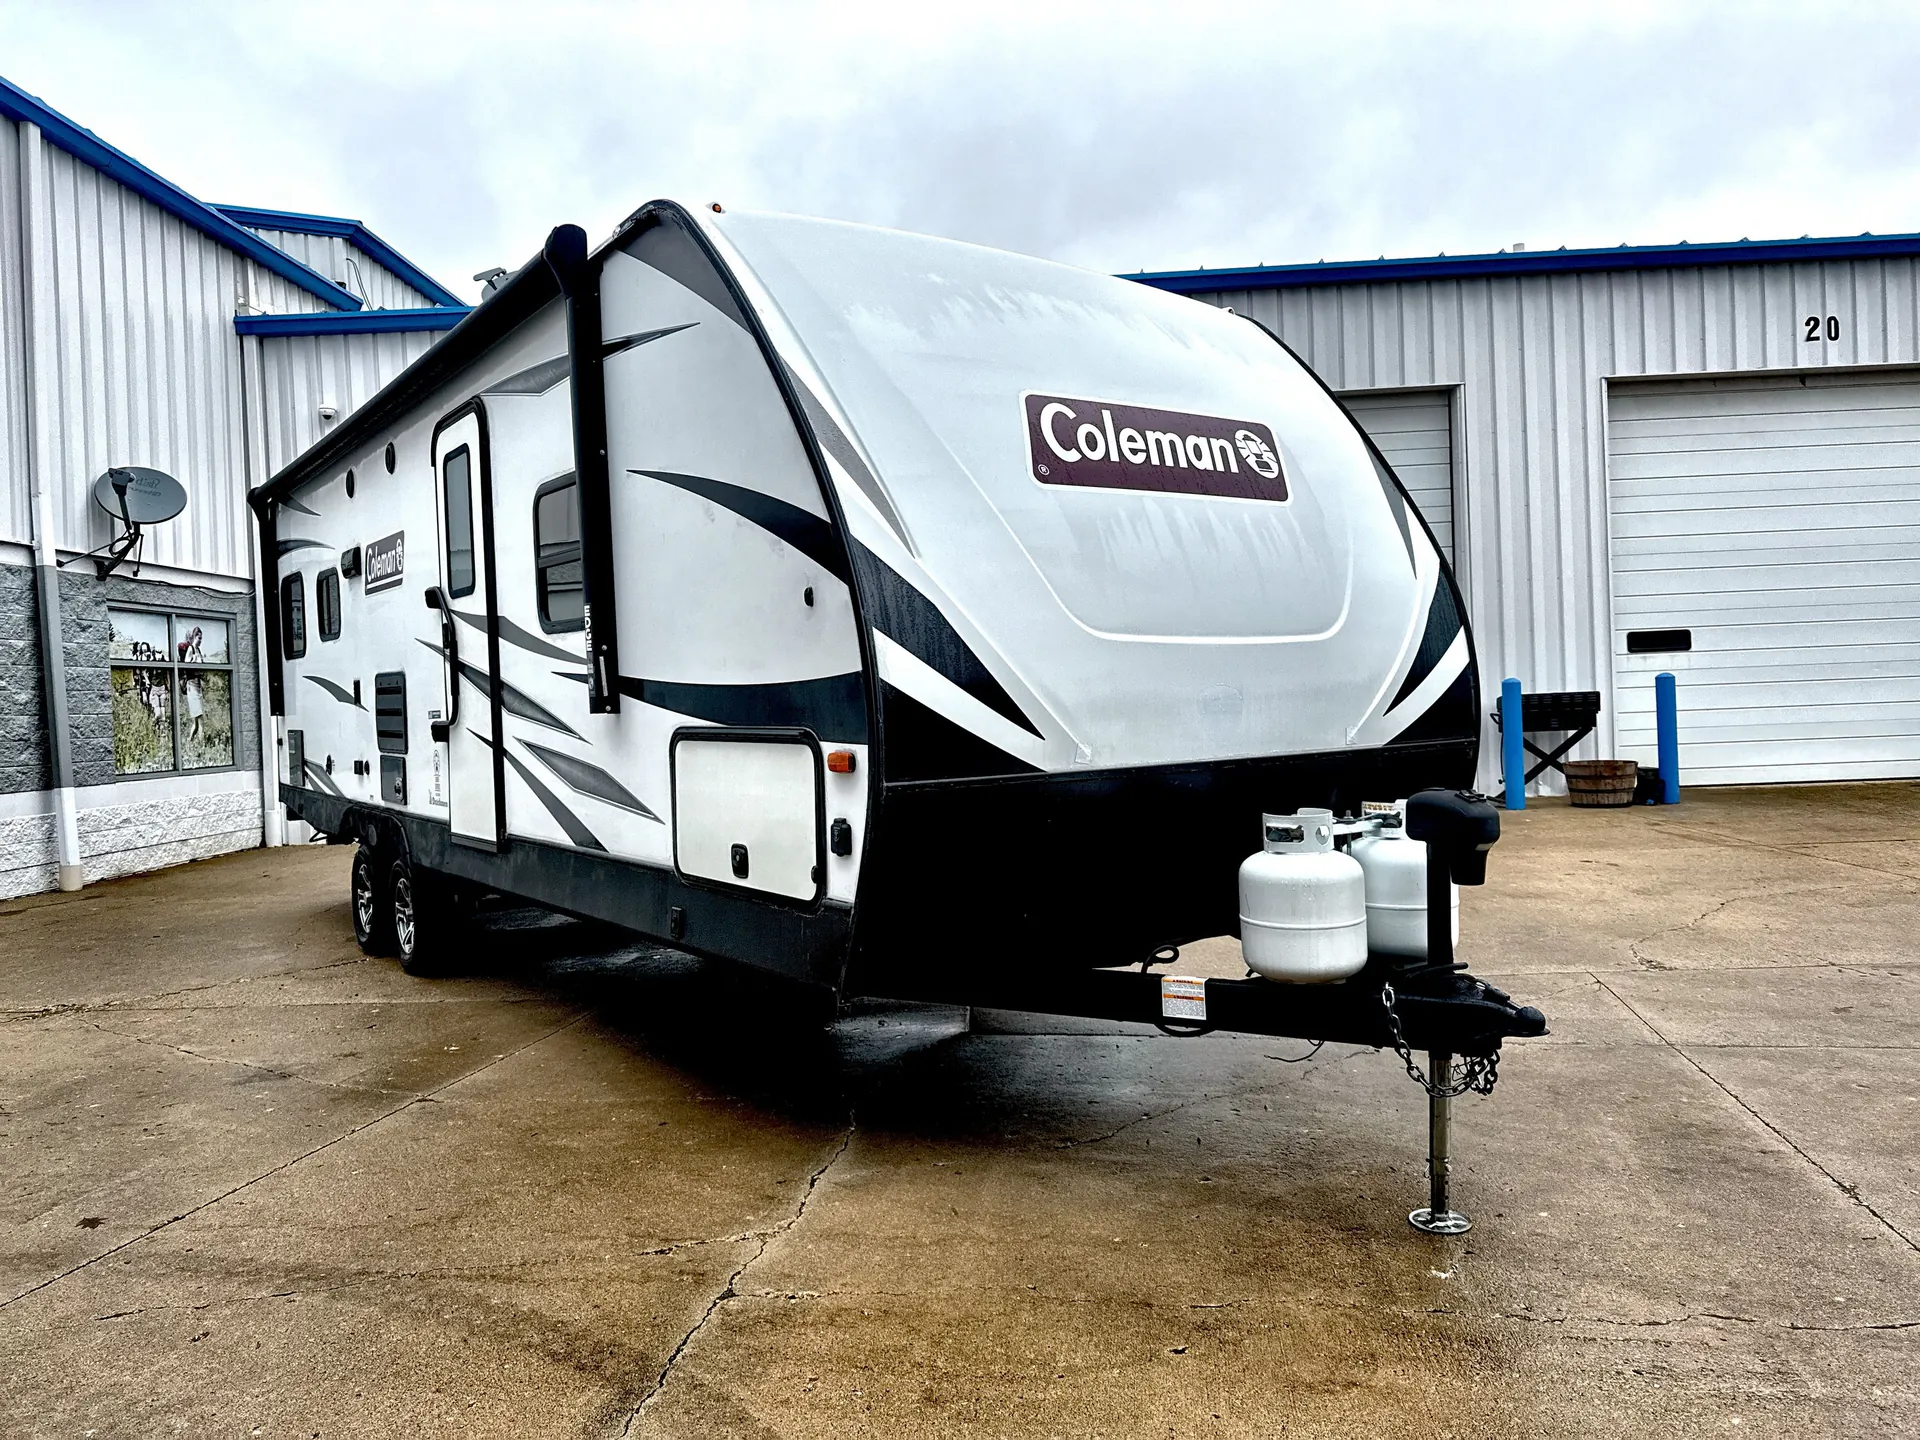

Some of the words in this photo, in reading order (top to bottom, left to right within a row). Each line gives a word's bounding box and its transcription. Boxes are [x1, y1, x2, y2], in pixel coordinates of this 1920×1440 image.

[1804, 315, 1840, 342] 20
[1040, 403, 1240, 474] Coleman
[366, 545, 396, 583] Coleman
[583, 604, 593, 652] EDGE
